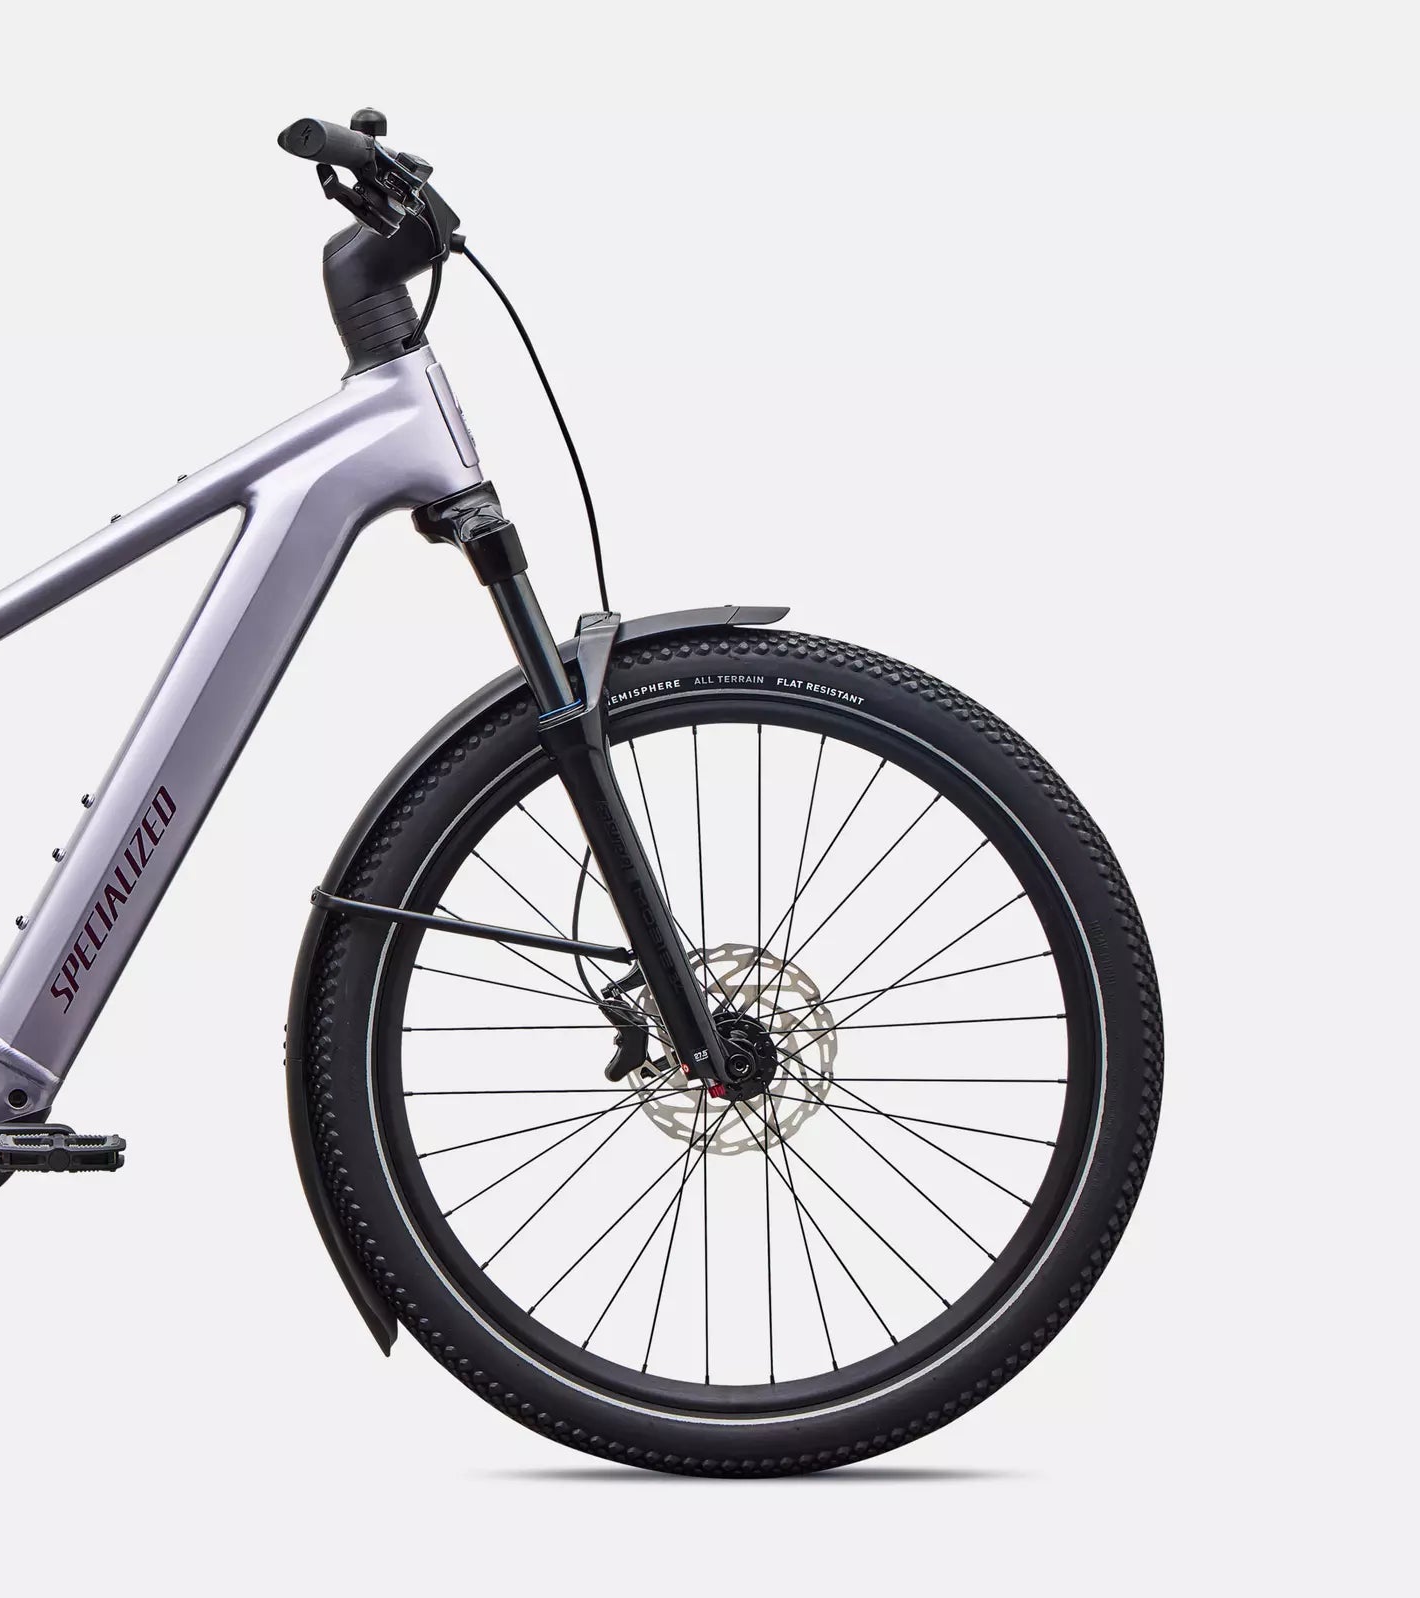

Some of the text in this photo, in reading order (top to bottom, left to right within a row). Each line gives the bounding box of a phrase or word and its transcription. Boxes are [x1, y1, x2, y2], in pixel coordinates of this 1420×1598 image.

[694, 675, 715, 685] ALL
[716, 675, 764, 684] TERRAIN
[776, 677, 803, 689] FLAT
[805, 681, 865, 705] RESISTANT
[50, 785, 177, 1014] SPECIALIZED
